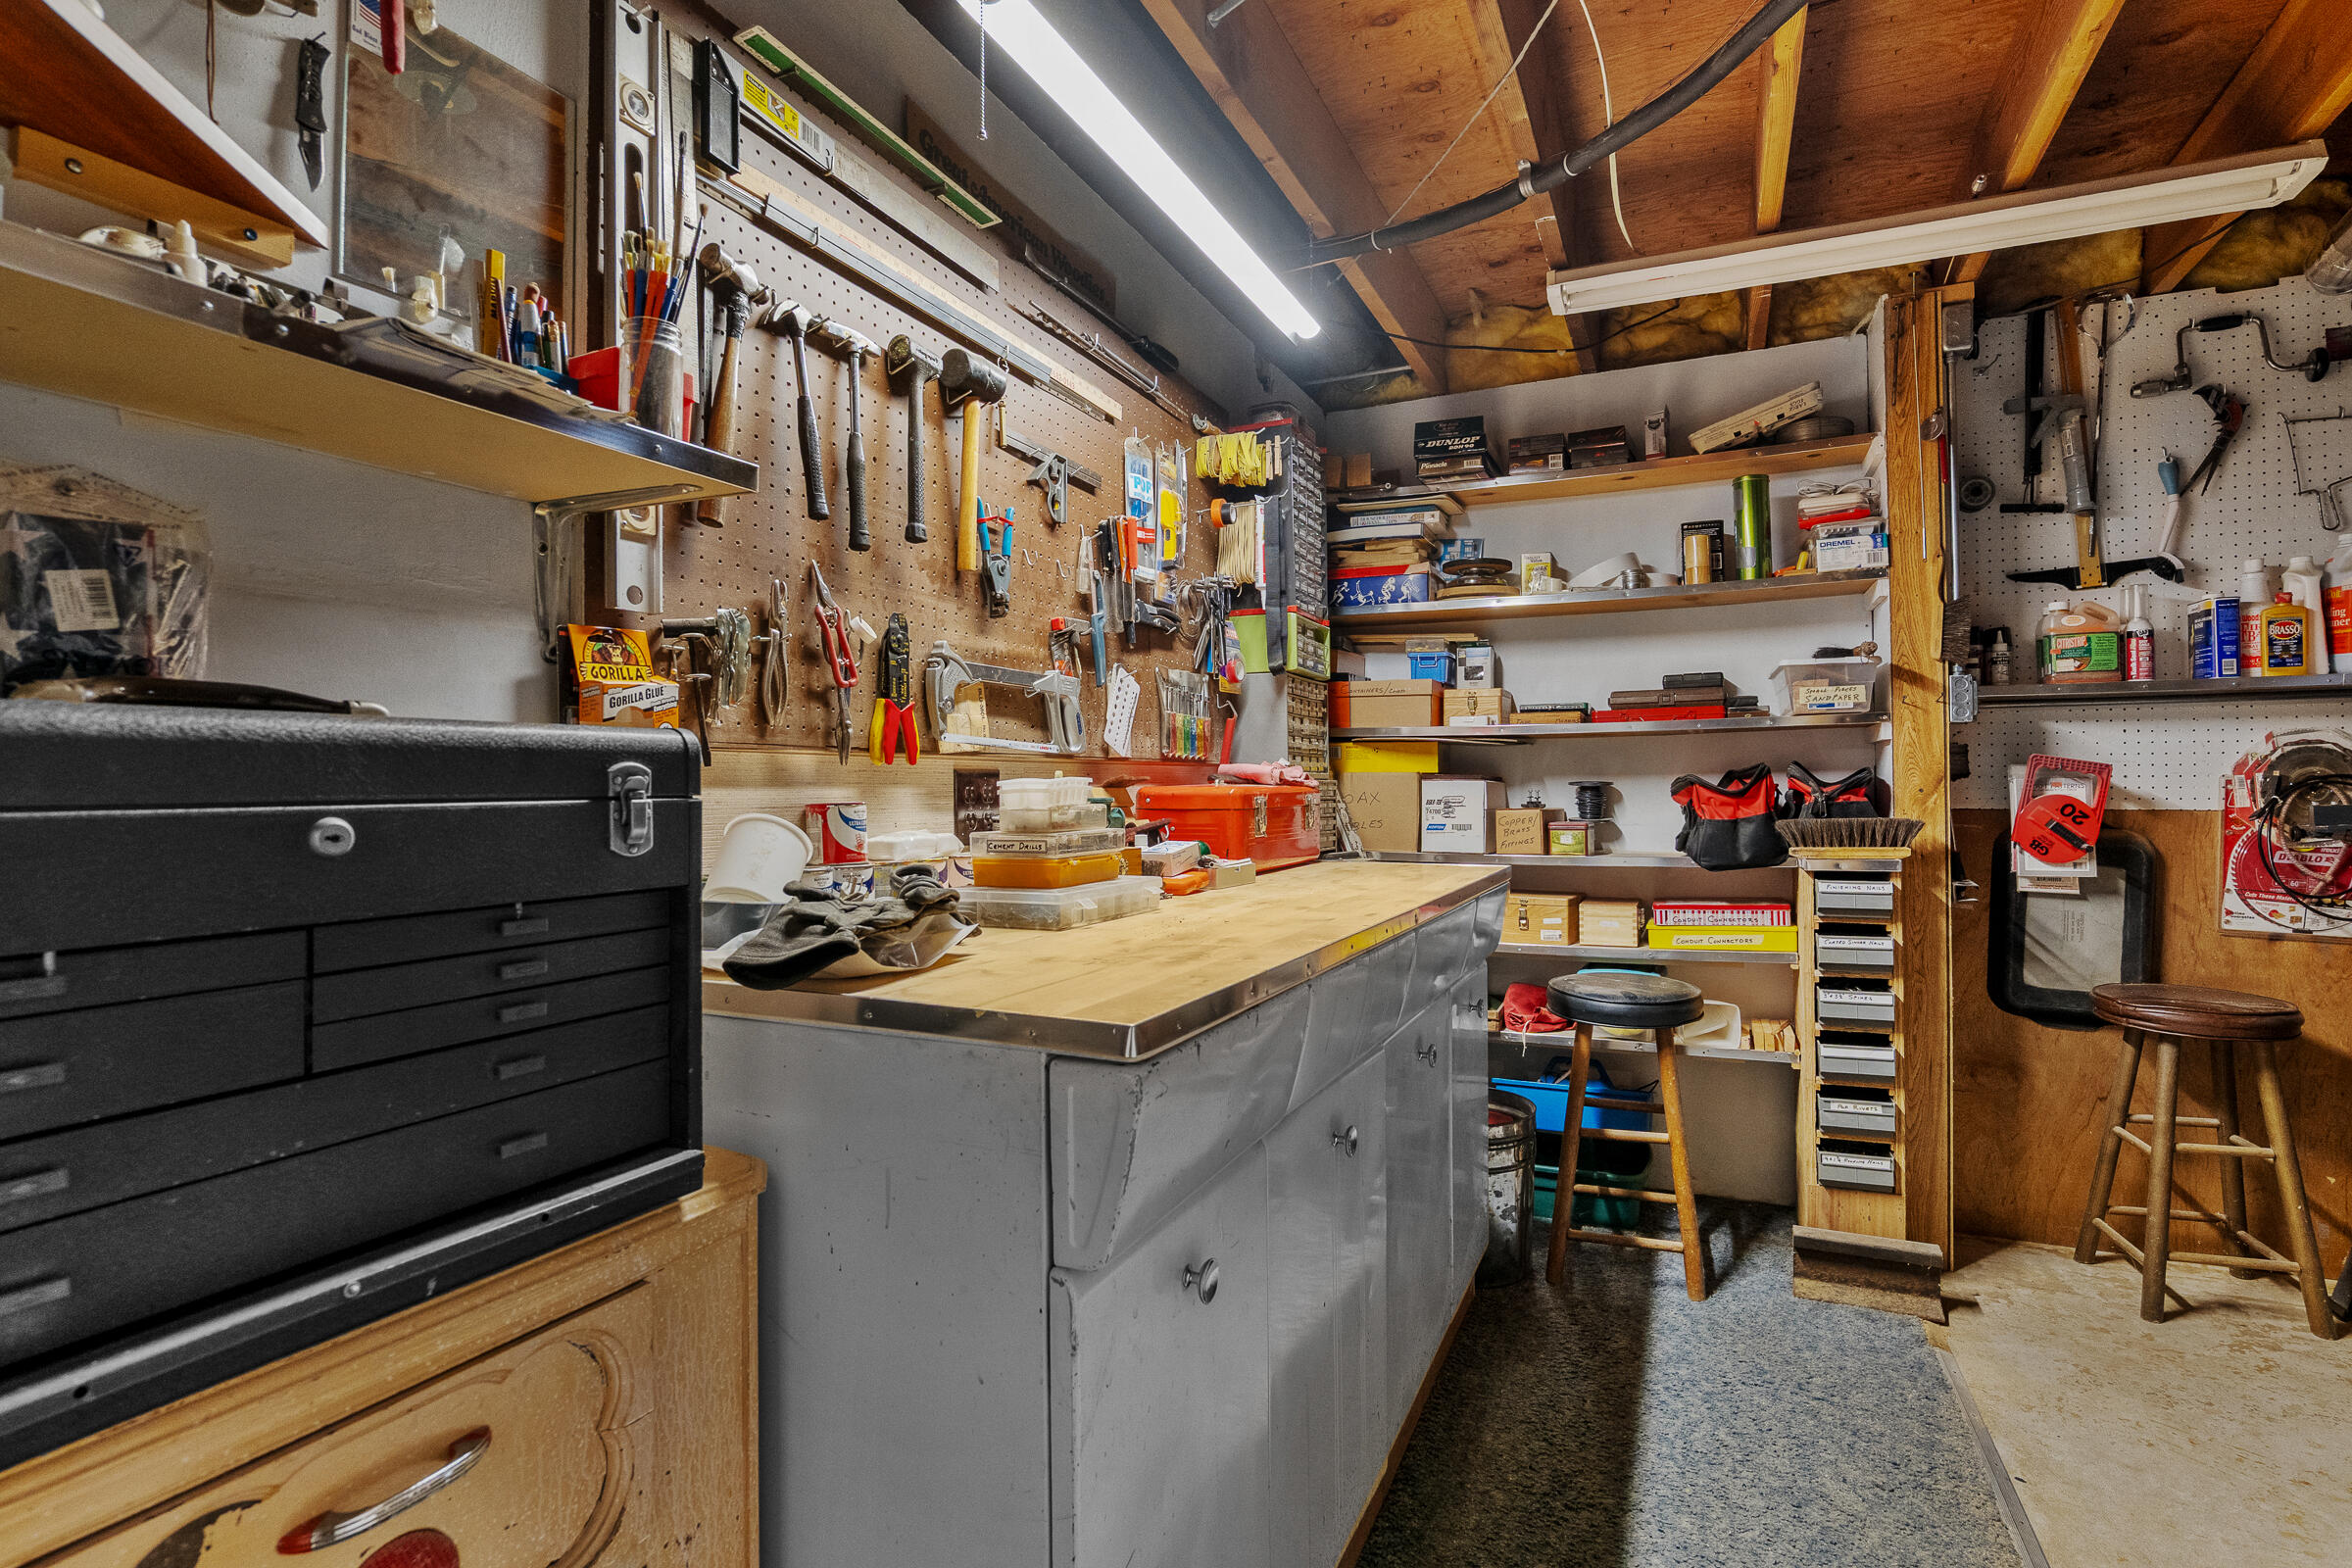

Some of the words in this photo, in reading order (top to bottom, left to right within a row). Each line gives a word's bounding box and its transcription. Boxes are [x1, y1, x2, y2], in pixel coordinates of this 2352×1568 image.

[1426, 435, 1481, 448] DUNLOP
[1421, 461, 1447, 469] Pinnacle
[1820, 539, 1856, 548] DREMEL
[2269, 623, 2300, 635] BRASSO
[591, 665, 645, 681] GORILLA
[610, 692, 644, 709] GORILLA
[645, 686, 664, 700] GLUE
[1804, 694, 1861, 703] SANDPAPER
[1344, 791, 1381, 805] OAX
[2060, 804, 2090, 825] 20
[1352, 819, 1384, 831] BLES
[1504, 826, 1532, 836] BRASS
[988, 842, 1015, 851] CEMENT
[1018, 842, 1043, 851] DRILLS
[1500, 837, 1535, 849] FITTINGS
[2030, 839, 2049, 856] GB
[1707, 915, 1759, 924] CONNECTORS
